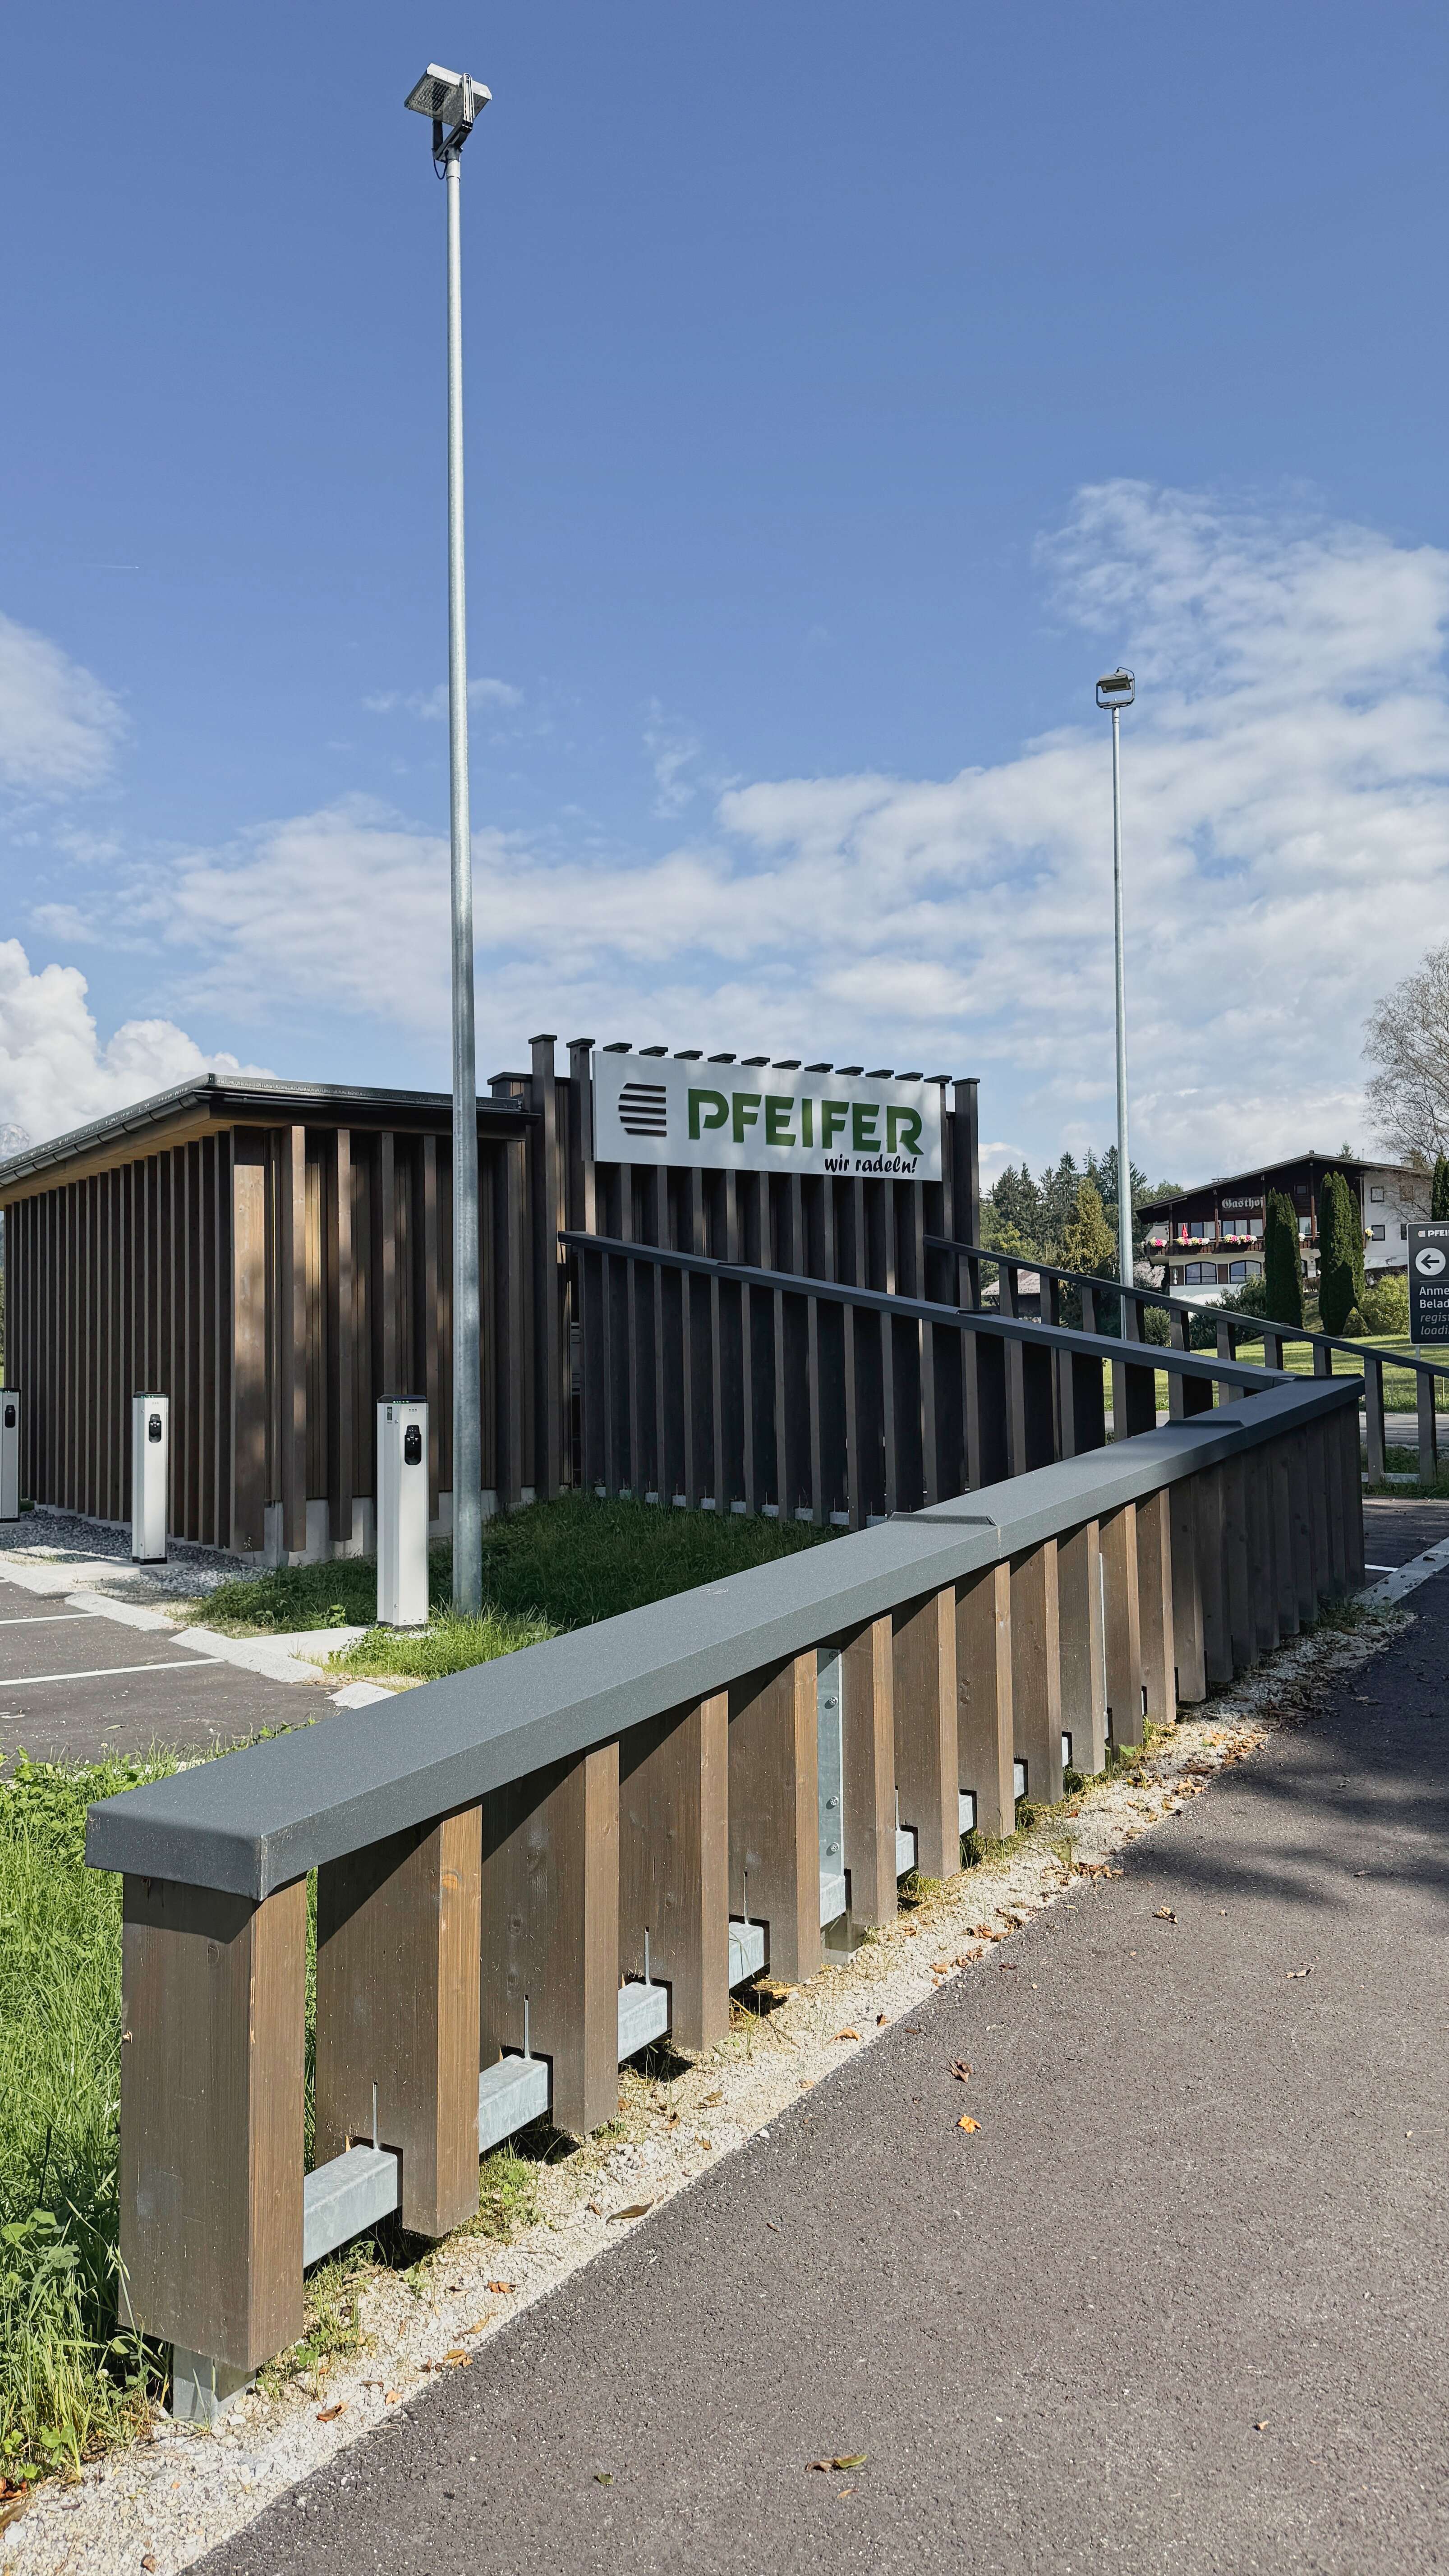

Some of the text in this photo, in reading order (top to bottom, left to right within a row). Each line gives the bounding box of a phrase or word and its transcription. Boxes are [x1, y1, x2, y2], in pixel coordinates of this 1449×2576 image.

[688, 1088, 924, 1155] PFEIFER
[824, 1154, 917, 1173] wir radeln!
[1421, 1325, 1449, 1335] loadi
